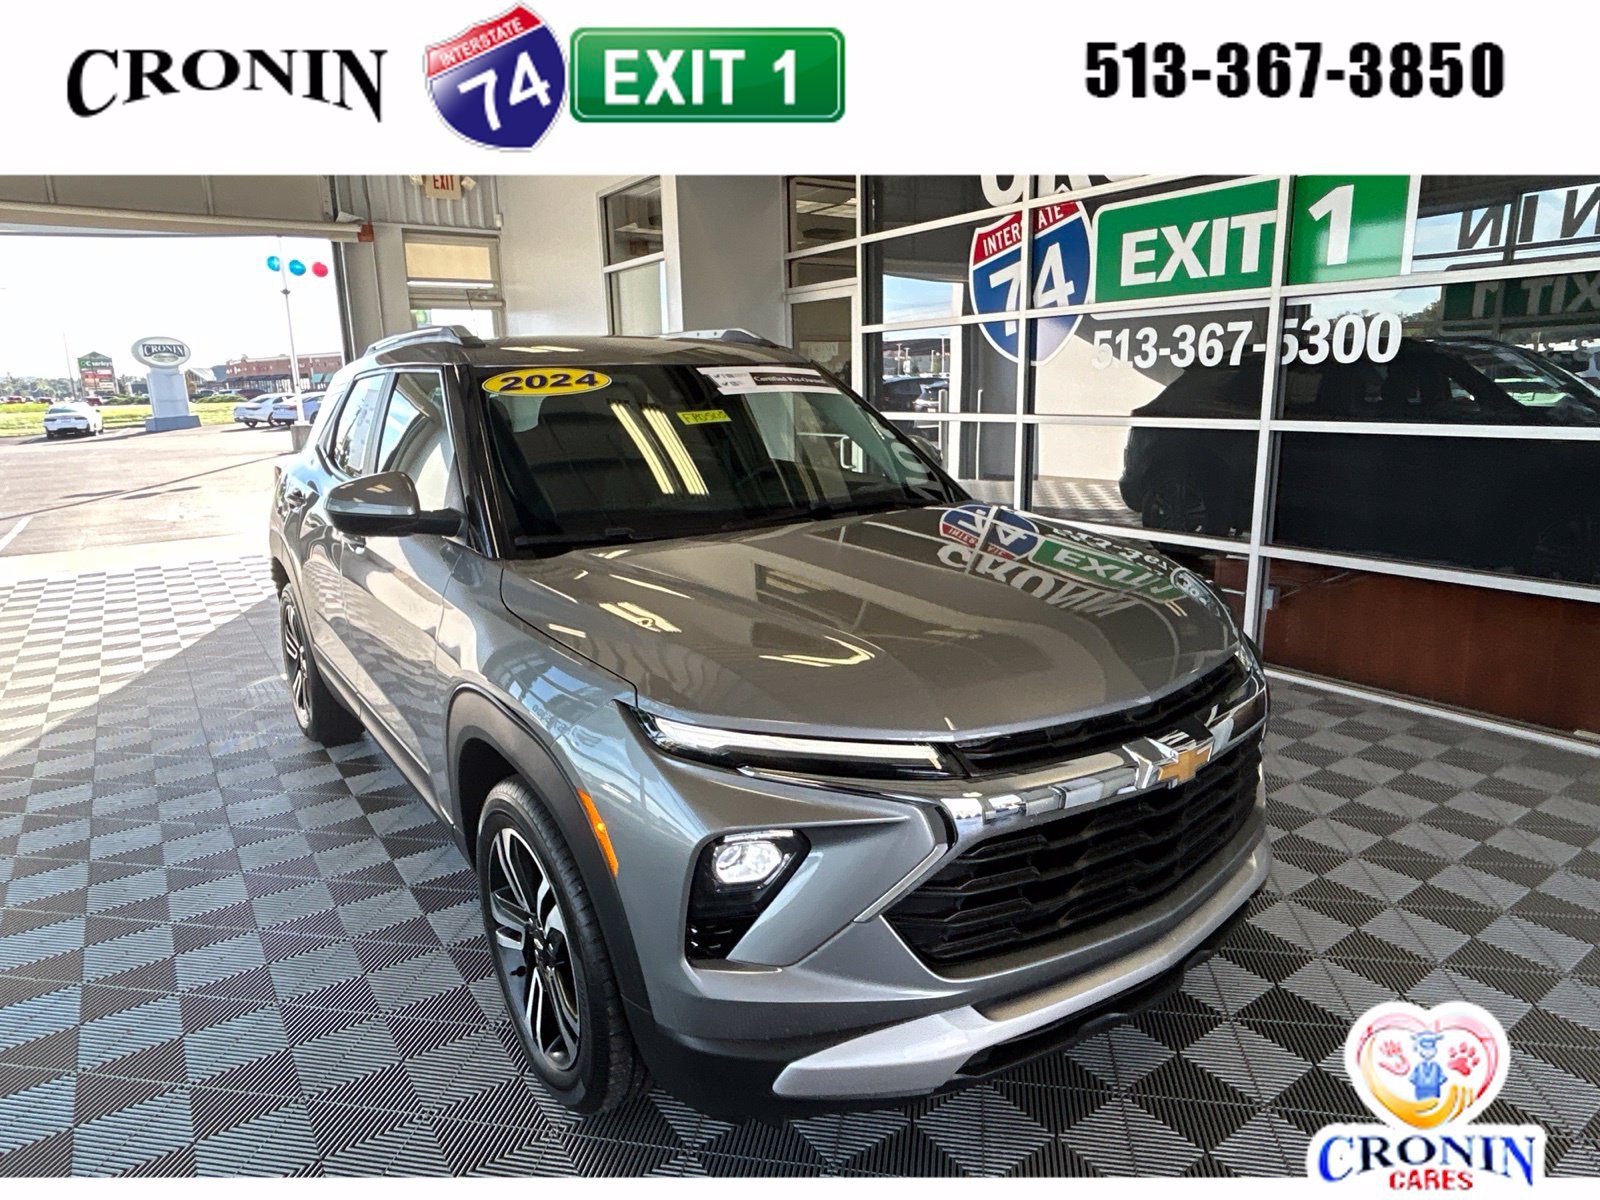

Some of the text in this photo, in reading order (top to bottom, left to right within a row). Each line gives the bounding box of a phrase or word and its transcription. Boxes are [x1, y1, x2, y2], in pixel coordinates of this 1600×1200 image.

[432, 174, 454, 191] EXIT
[983, 205, 1064, 257] INTERATE
[1120, 184, 1354, 287] EXIT 1
[989, 242, 1075, 337] 74
[144, 344, 184, 356] CRONIN
[1091, 312, 1402, 369] 513-367-5300
[499, 373, 599, 392] 2024
